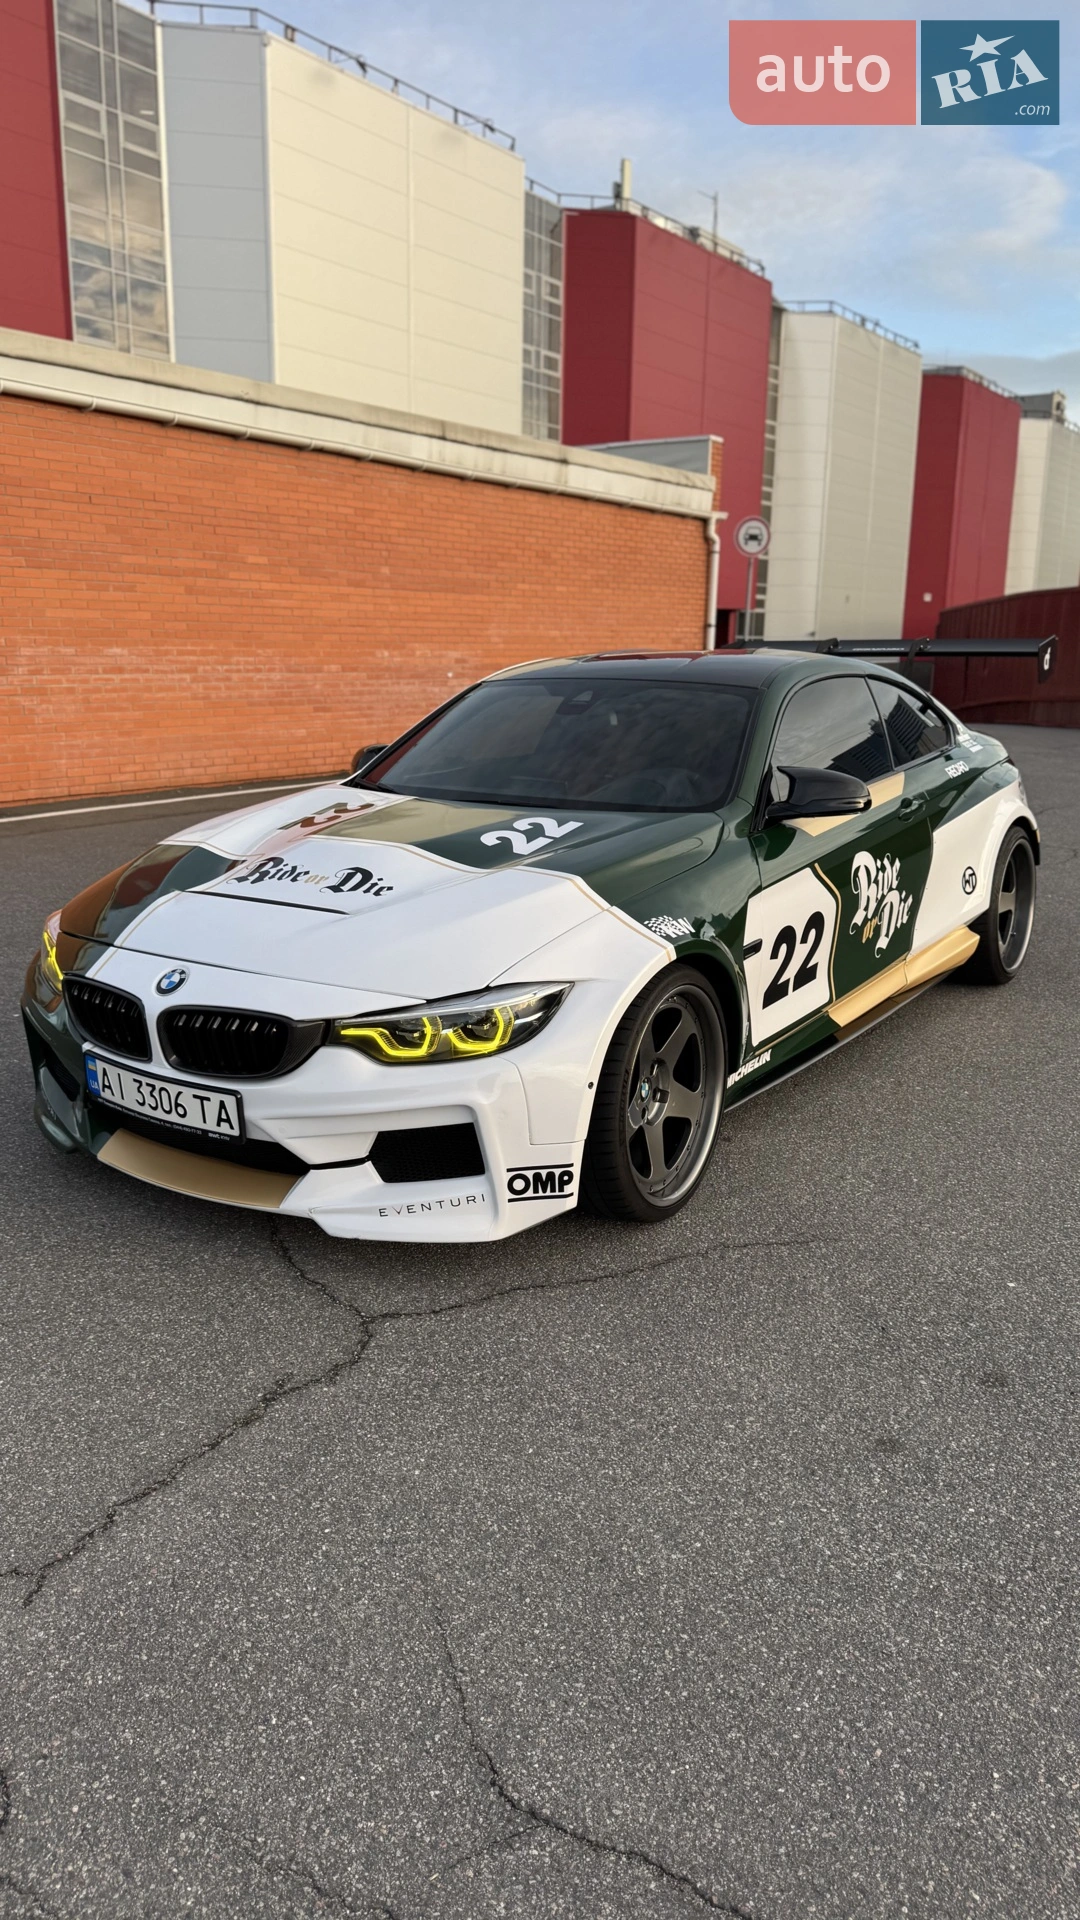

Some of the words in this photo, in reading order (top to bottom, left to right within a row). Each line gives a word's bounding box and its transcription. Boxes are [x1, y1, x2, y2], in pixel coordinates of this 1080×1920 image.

[944, 760, 970, 779] RECARO
[480, 816, 584, 855] 22
[226, 856, 311, 884] Ride
[304, 872, 330, 885] or
[319, 866, 394, 896] Die
[850, 851, 901, 935] Ride
[861, 916, 878, 944] or
[874, 889, 913, 958] Die
[762, 911, 825, 1010] 22
[90, 1079, 99, 1090] UA
[101, 1067, 125, 1100] AI
[132, 1078, 187, 1118] 3306
[192, 1094, 235, 1130] TA
[507, 1170, 574, 1195] OMP
[378, 1194, 485, 1217] EVENTURI
